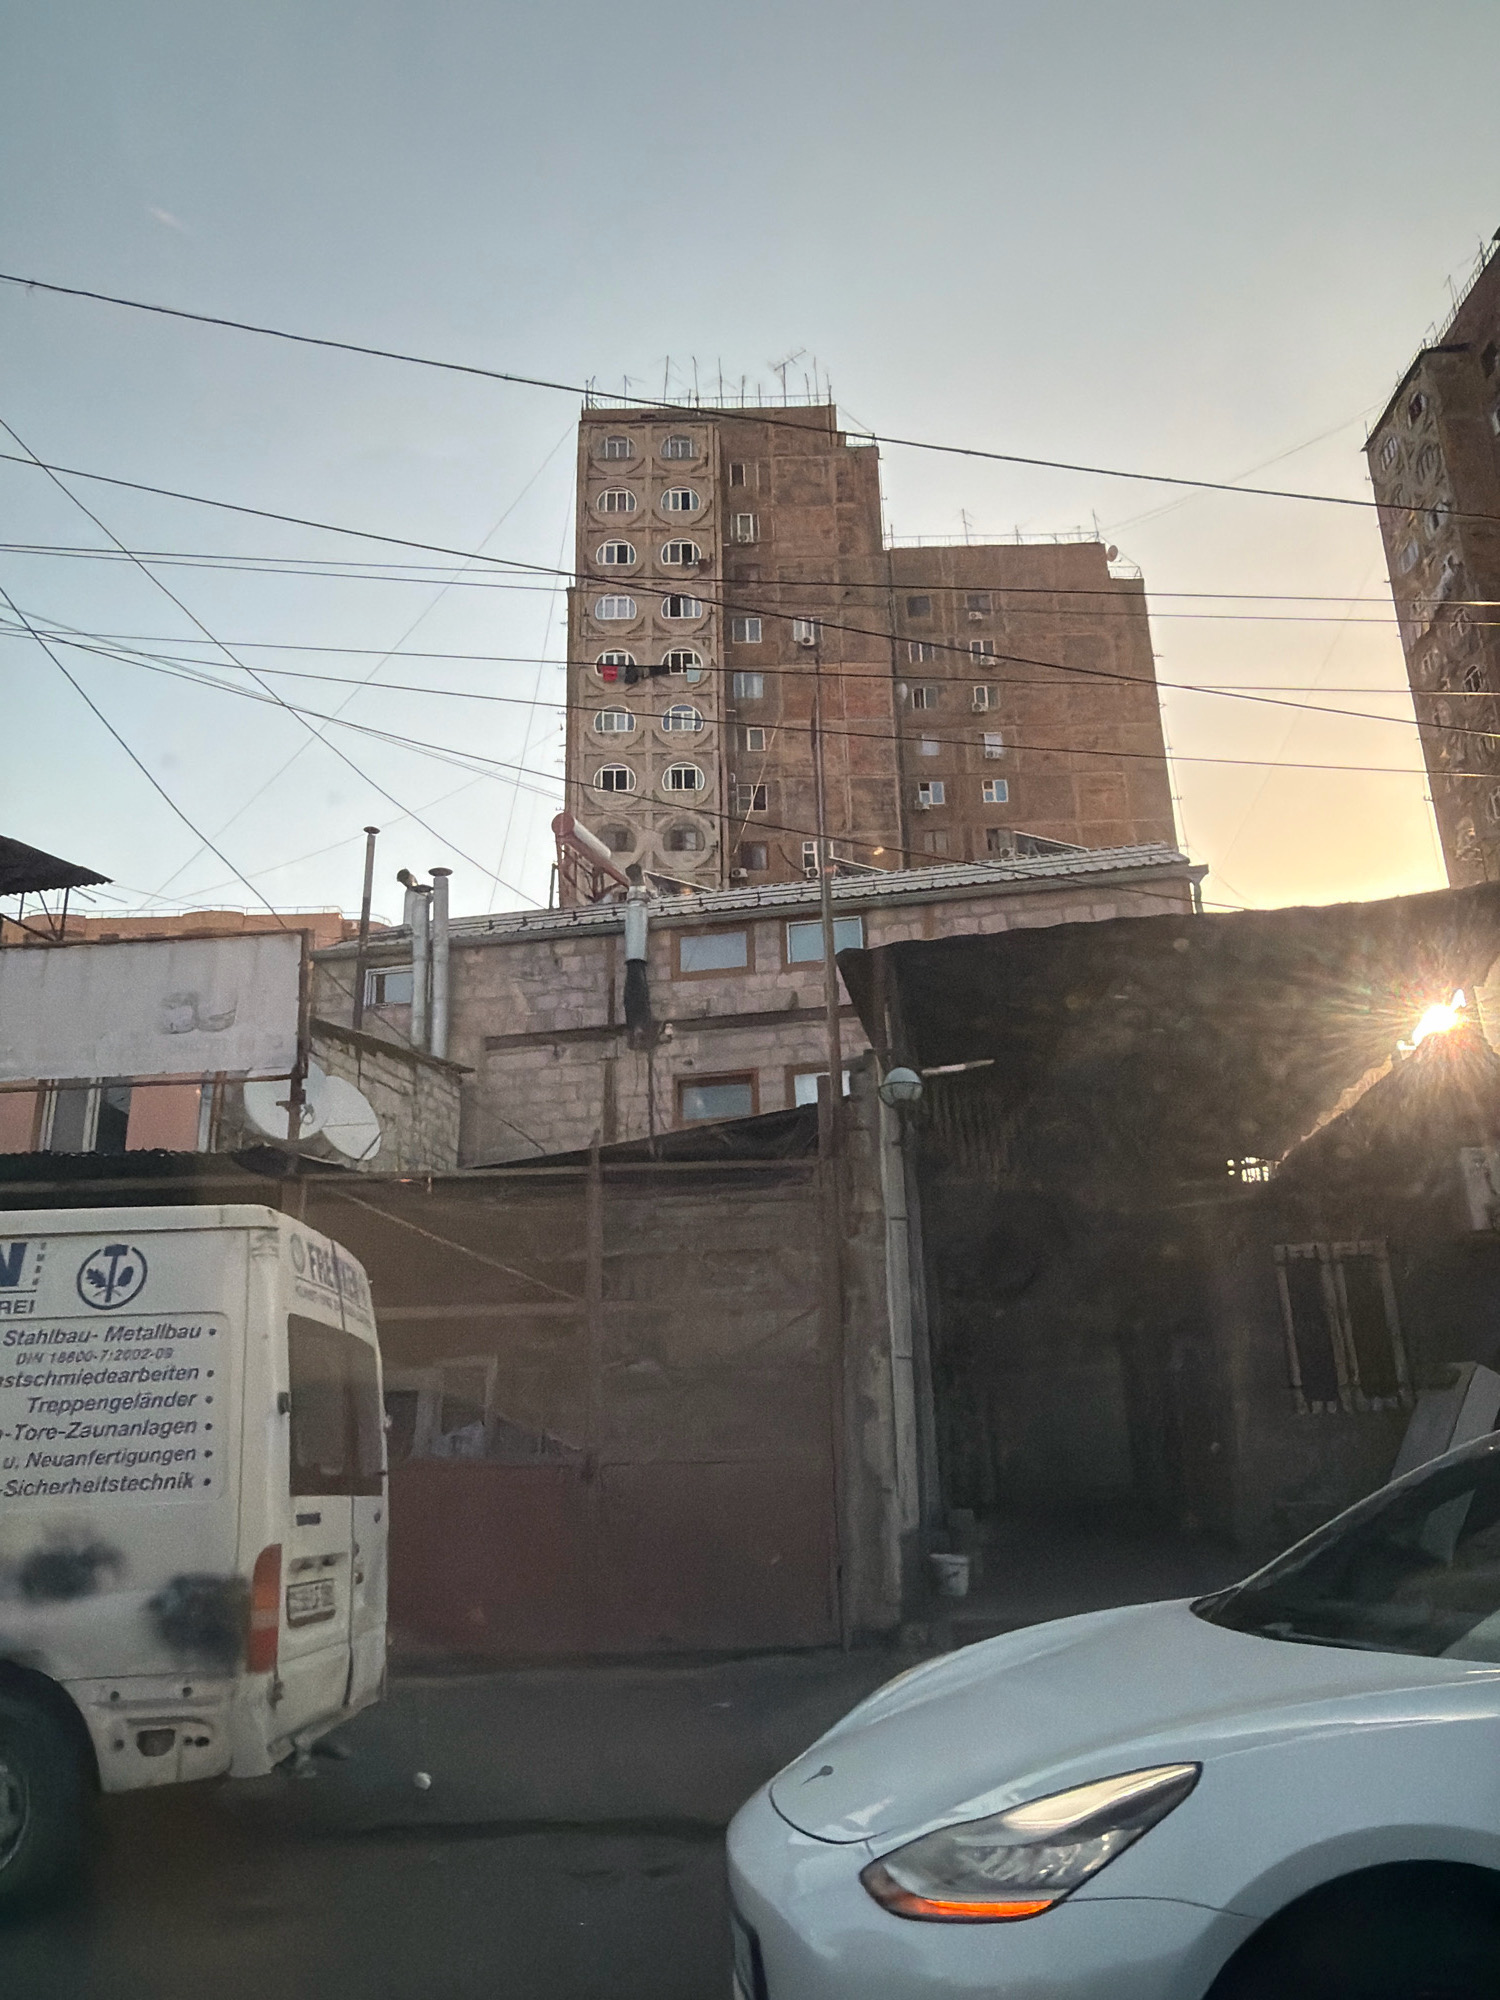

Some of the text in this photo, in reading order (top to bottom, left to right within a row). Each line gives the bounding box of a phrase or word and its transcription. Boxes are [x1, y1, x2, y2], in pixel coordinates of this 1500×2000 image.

[2, 1323, 202, 1347] Stahlbau- Metallbau
[16, 1352, 44, 1366] DIN
[28, 1391, 199, 1416] Treppengeländer
[25, 1448, 197, 1468] Neuanfertigungen
